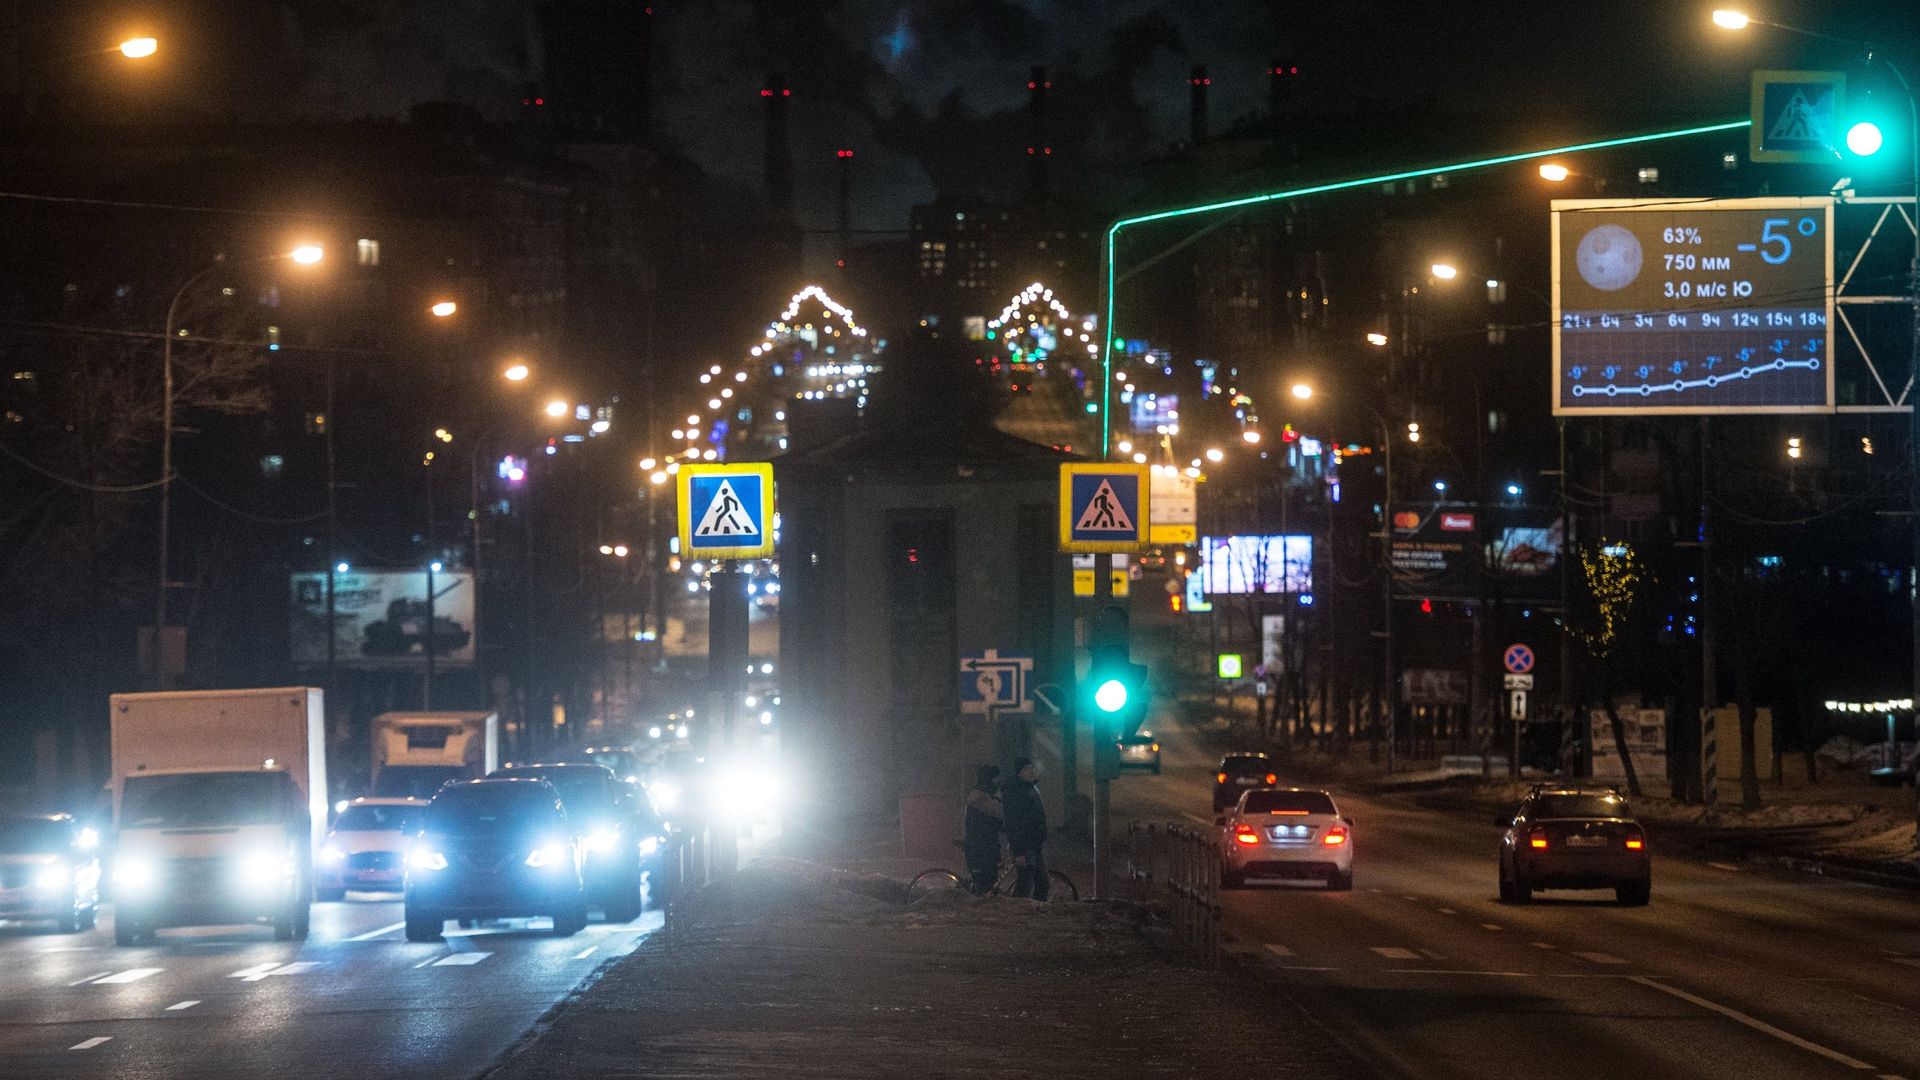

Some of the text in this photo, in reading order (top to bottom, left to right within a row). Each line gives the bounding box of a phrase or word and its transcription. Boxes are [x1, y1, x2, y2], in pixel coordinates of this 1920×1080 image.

[1663, 227, 1702, 245] 63%
[1663, 254, 1731, 271] 750 мм
[1664, 280, 1753, 300] 3,0 м/с Ю
[1634, 313, 1653, 328] 3ч
[1668, 312, 1687, 327] 6ч
[1702, 312, 1720, 327] 9ч
[1732, 312, 1759, 327] 12ч
[1766, 312, 1793, 327] 15ч
[1800, 311, 1826, 326] 18ч
